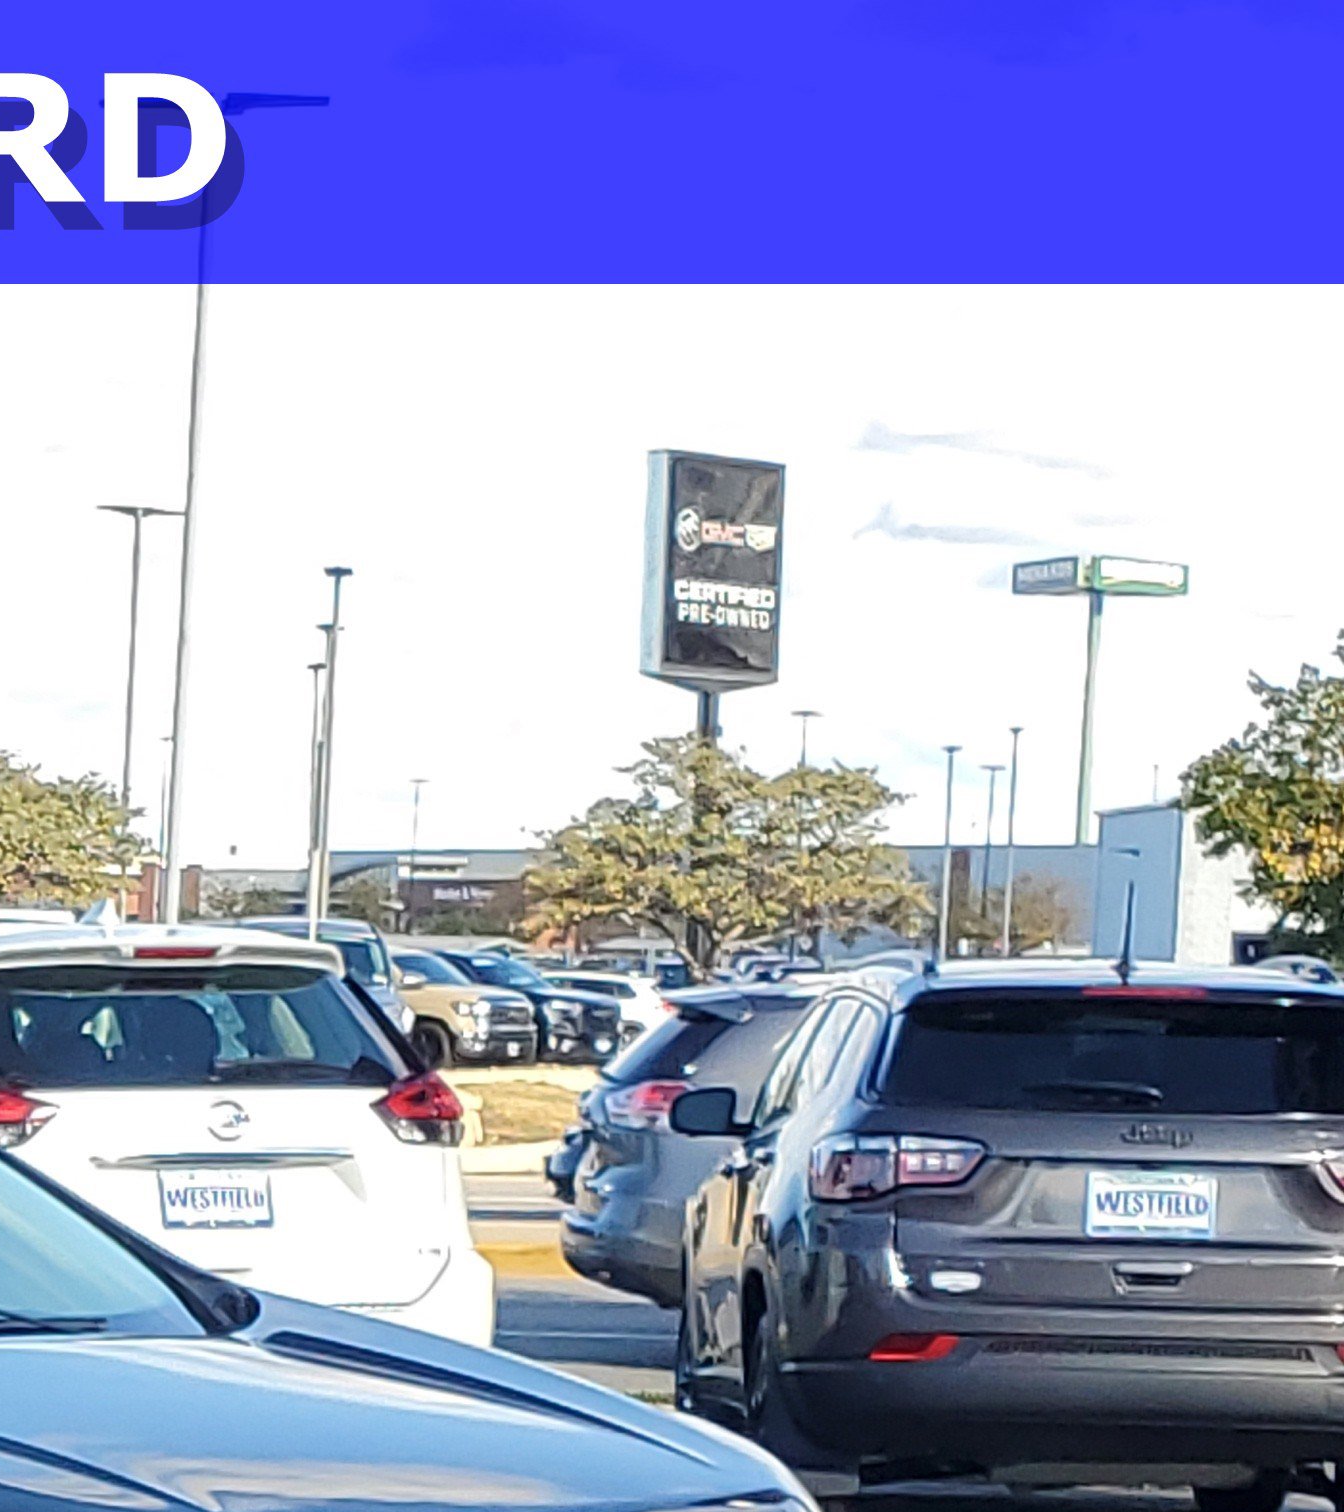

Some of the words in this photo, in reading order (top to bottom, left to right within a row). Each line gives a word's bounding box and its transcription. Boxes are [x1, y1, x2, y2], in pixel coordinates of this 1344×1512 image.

[673, 579, 776, 610] CERTIFIED
[677, 602, 771, 630] PRE-OWNED
[166, 1187, 265, 1210] WESTFIELD
[1095, 1190, 1210, 1217] WESTFIELD
